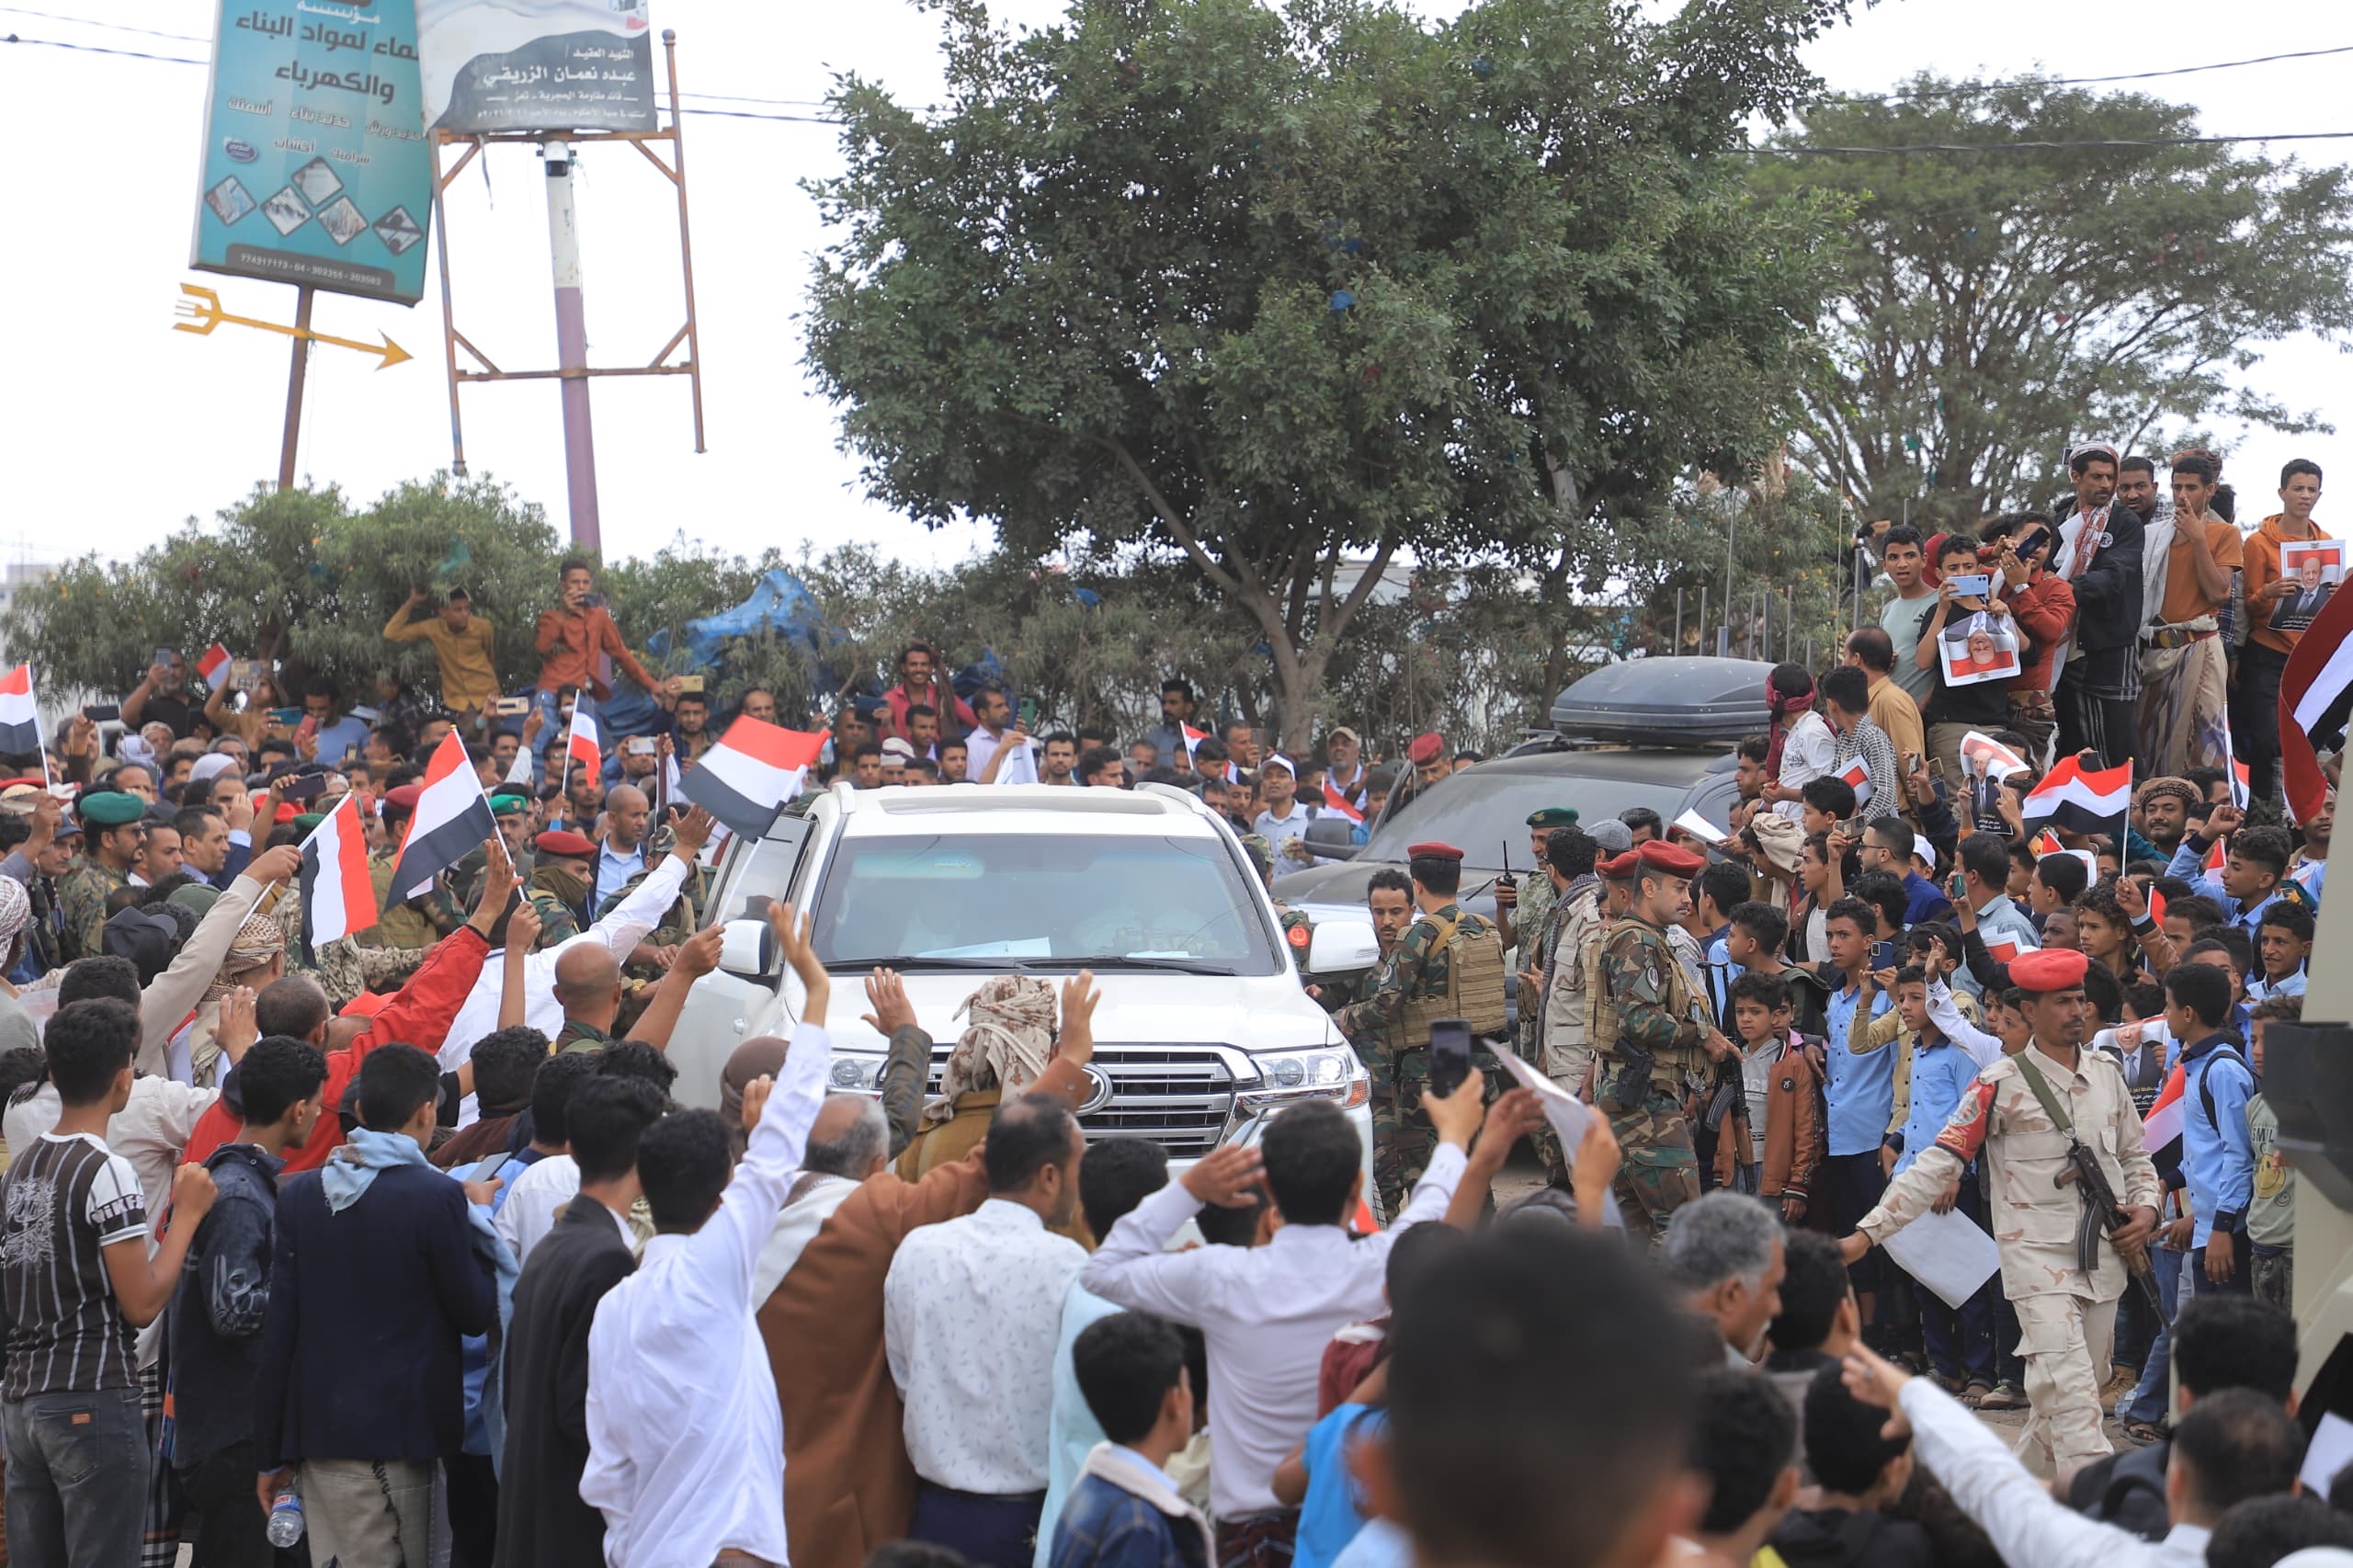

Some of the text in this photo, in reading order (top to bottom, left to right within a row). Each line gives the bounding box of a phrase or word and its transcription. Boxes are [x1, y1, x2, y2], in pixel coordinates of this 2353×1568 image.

[296, 0, 381, 25] مؤسسة
[235, 11, 293, 40] البناء
[301, 23, 367, 51] لمواد
[573, 47, 606, 61] العقيد
[607, 47, 634, 62] الشهيد
[275, 61, 395, 105] والكهرباء
[483, 64, 636, 87] عبده نعمان الزريقي
[228, 96, 273, 116] أسمنت
